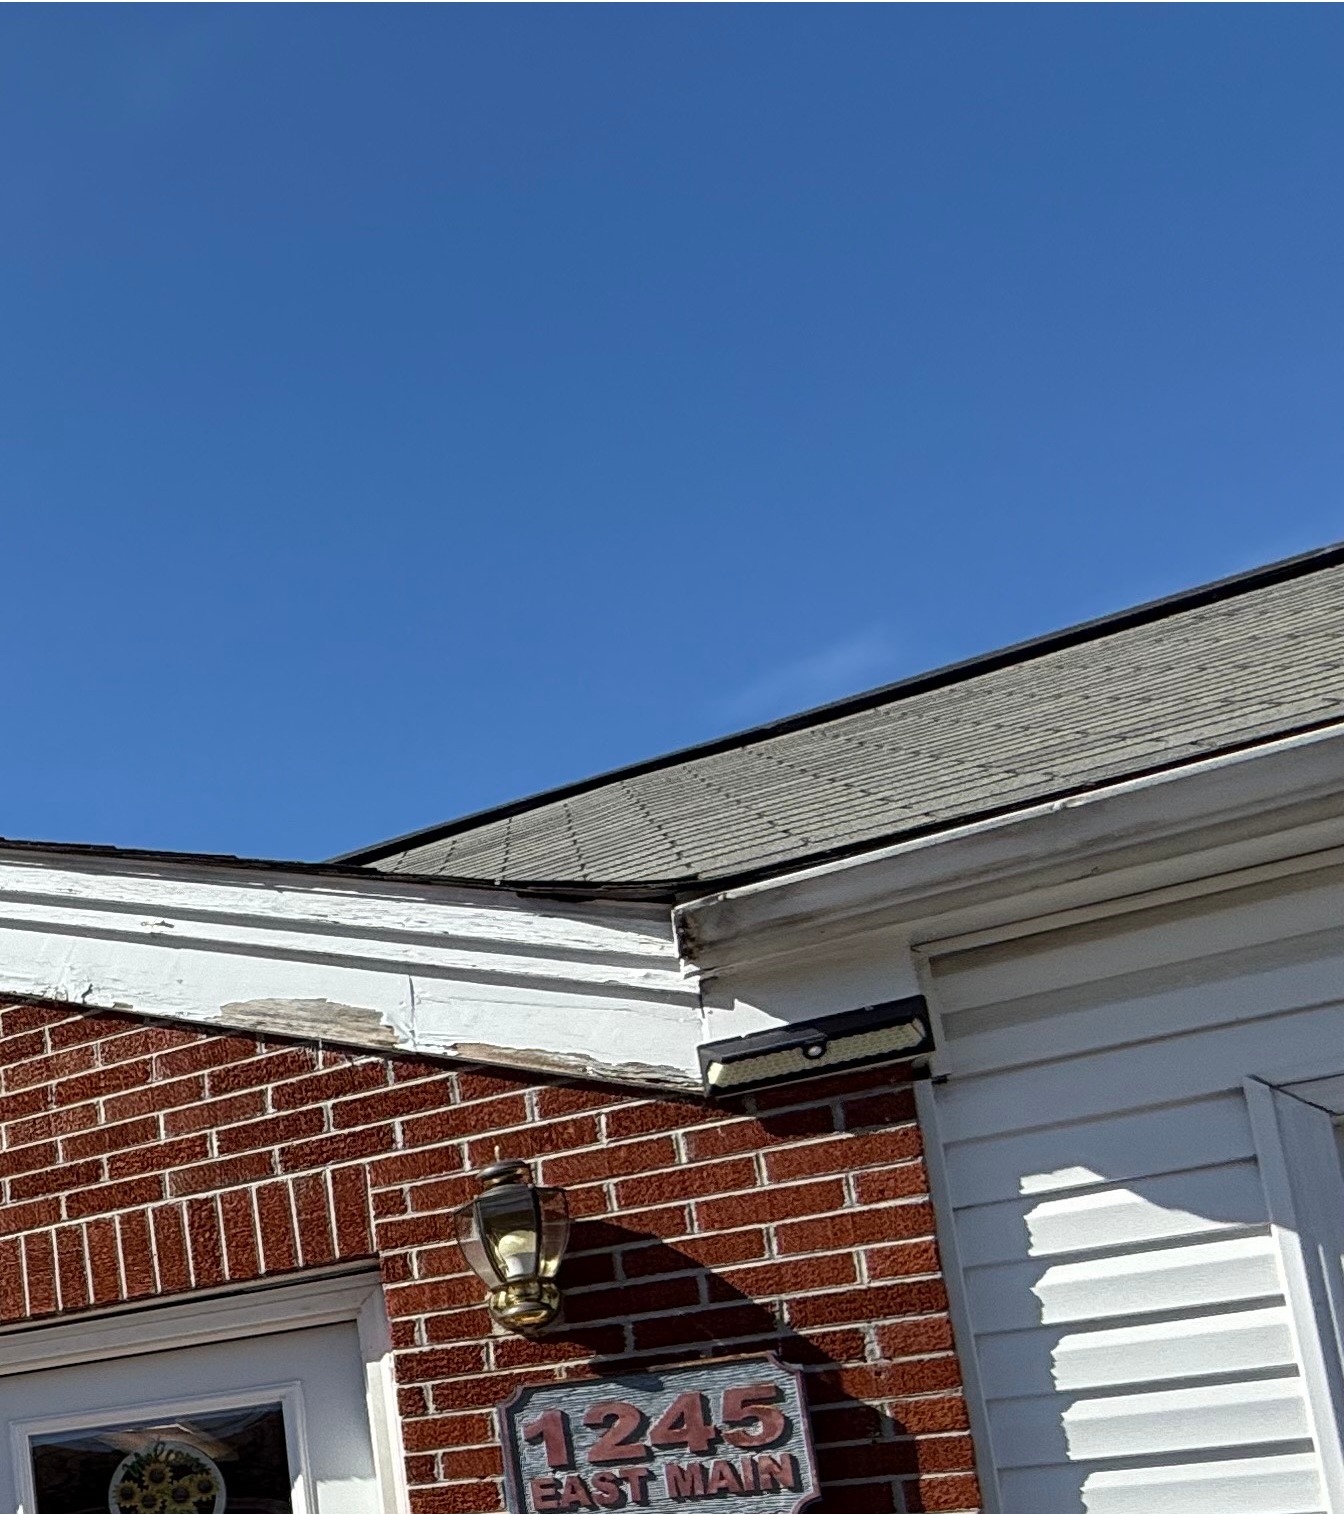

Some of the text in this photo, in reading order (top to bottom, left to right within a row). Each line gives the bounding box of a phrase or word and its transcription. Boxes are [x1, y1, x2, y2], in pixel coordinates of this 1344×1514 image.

[523, 1384, 786, 1467] 1245
[530, 1453, 795, 1511] EAST MAIN
